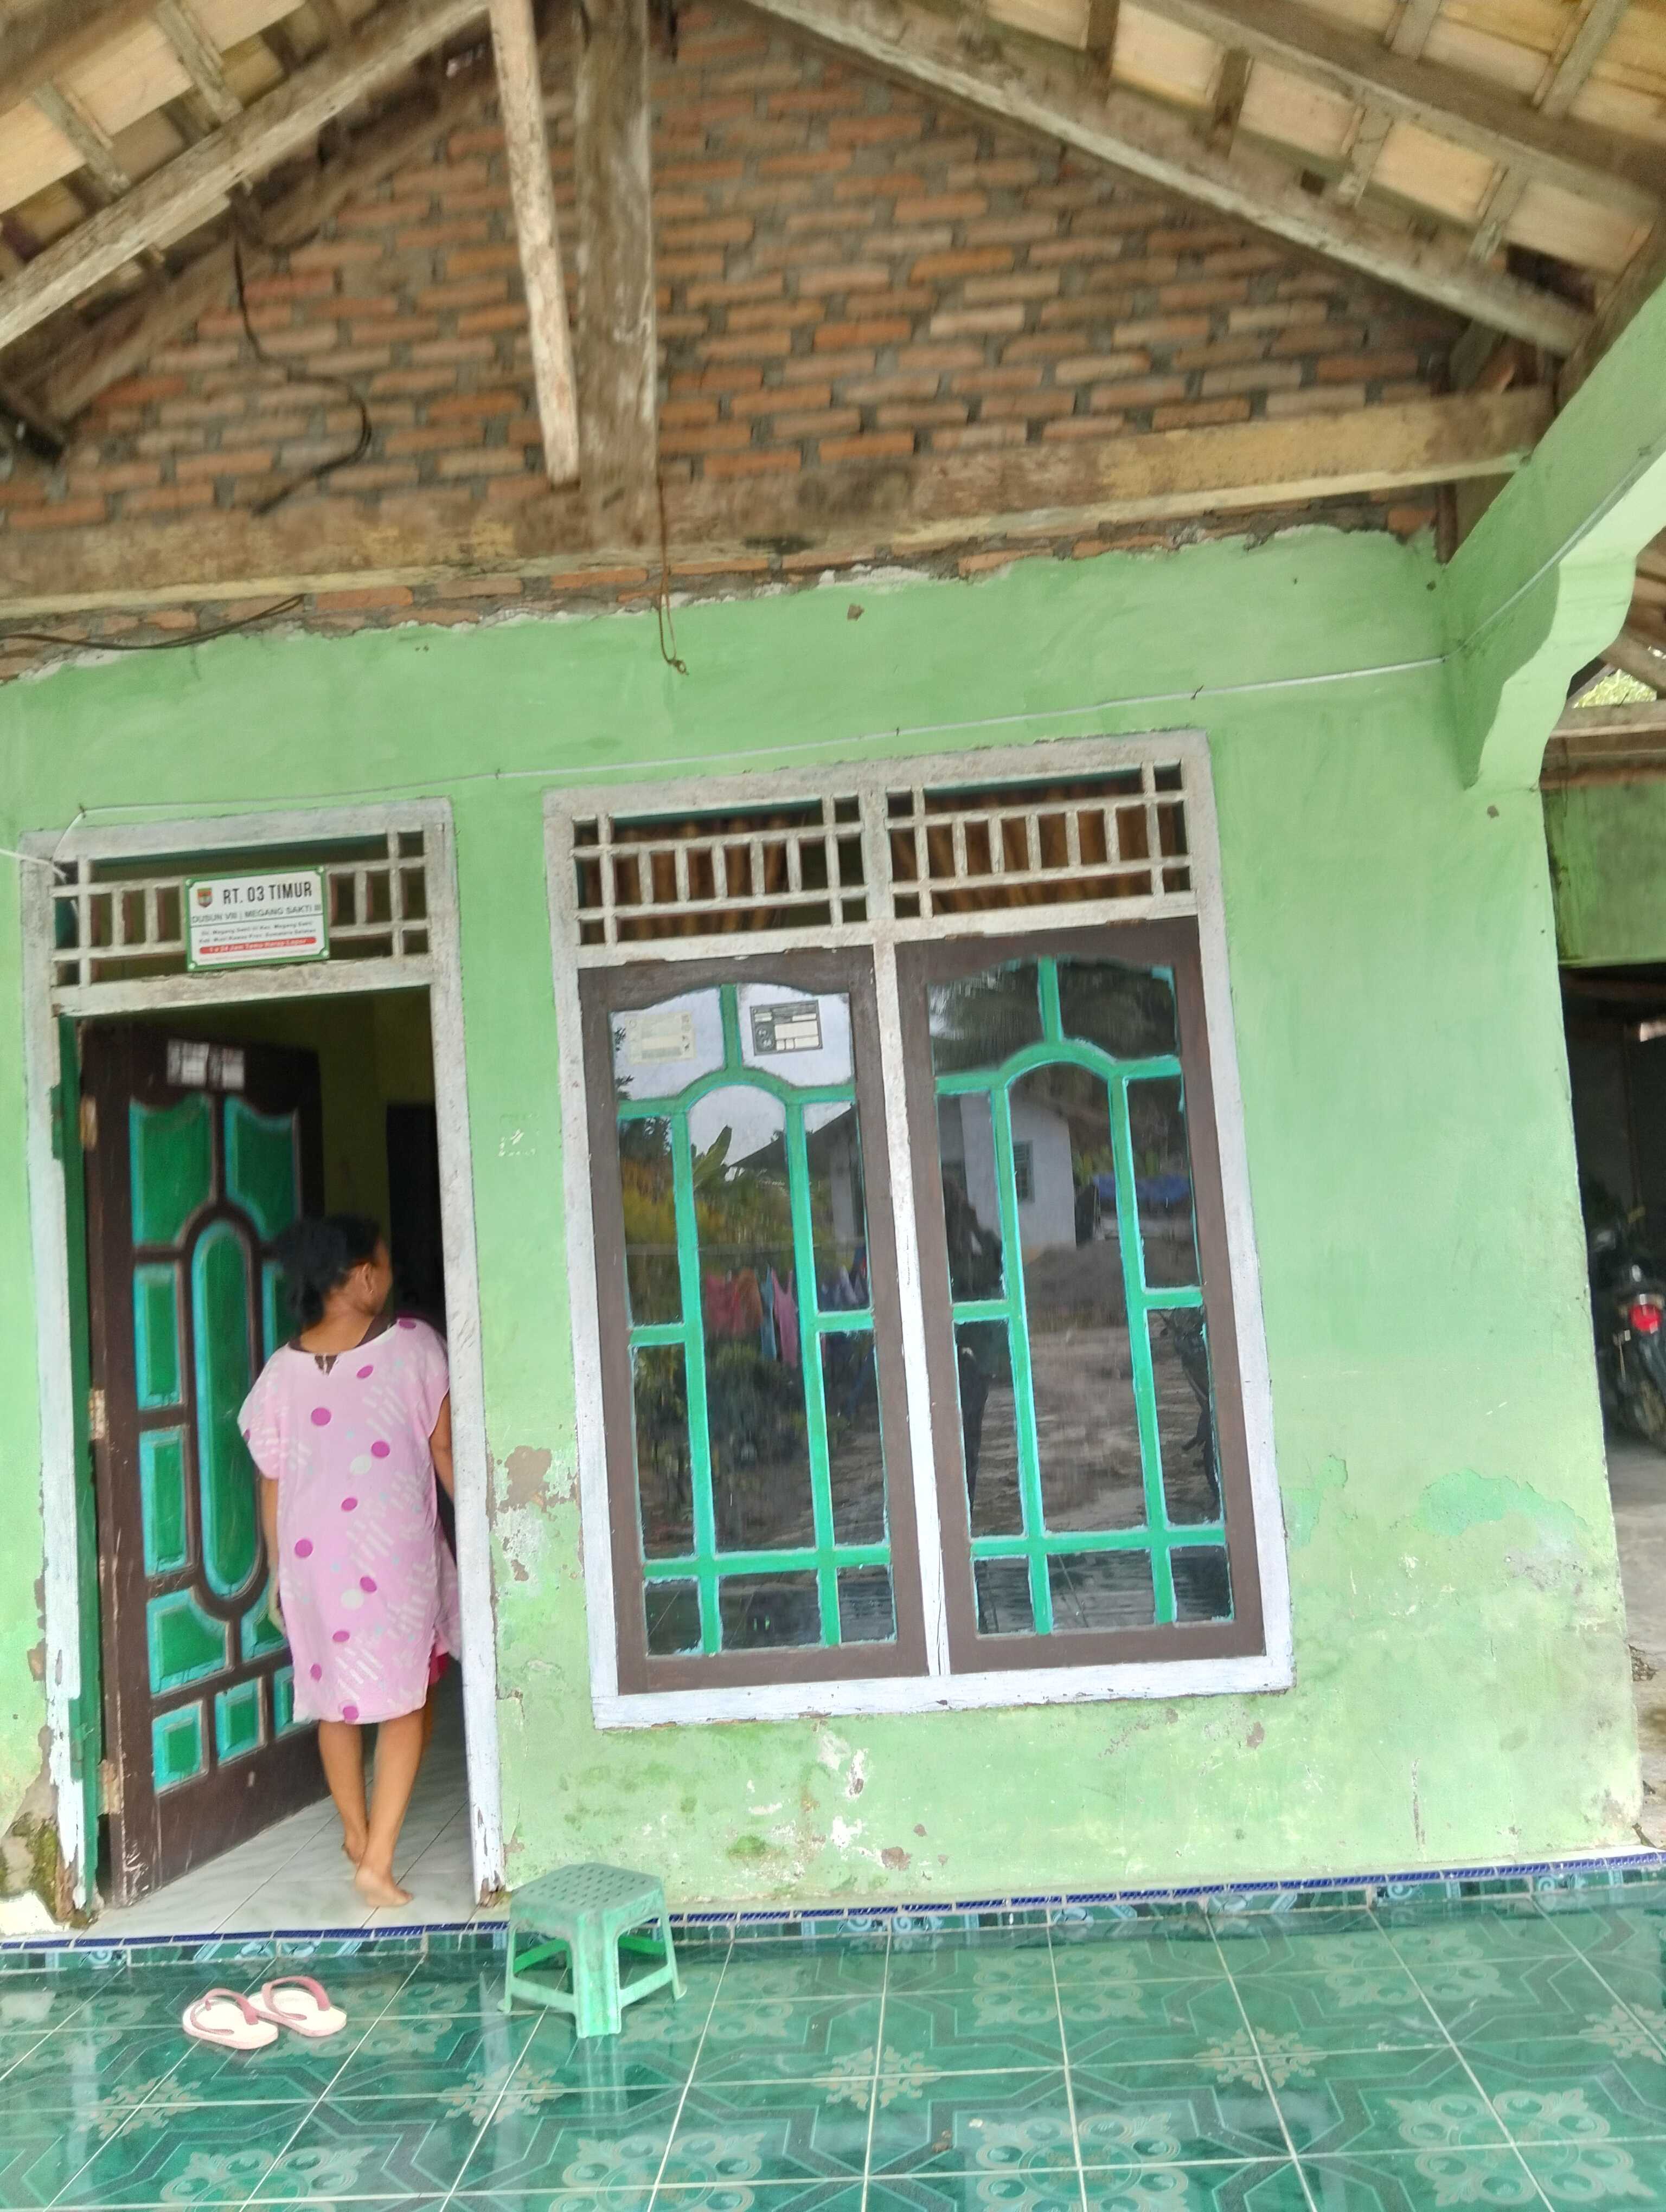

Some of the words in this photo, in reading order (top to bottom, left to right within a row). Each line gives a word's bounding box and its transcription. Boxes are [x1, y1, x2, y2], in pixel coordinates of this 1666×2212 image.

[223, 888, 244, 905] RT.
[247, 885, 265, 902] 03
[268, 881, 312, 900] TIMUR
[245, 907, 283, 918] MEGANG
[286, 905, 312, 914] SAKTI
